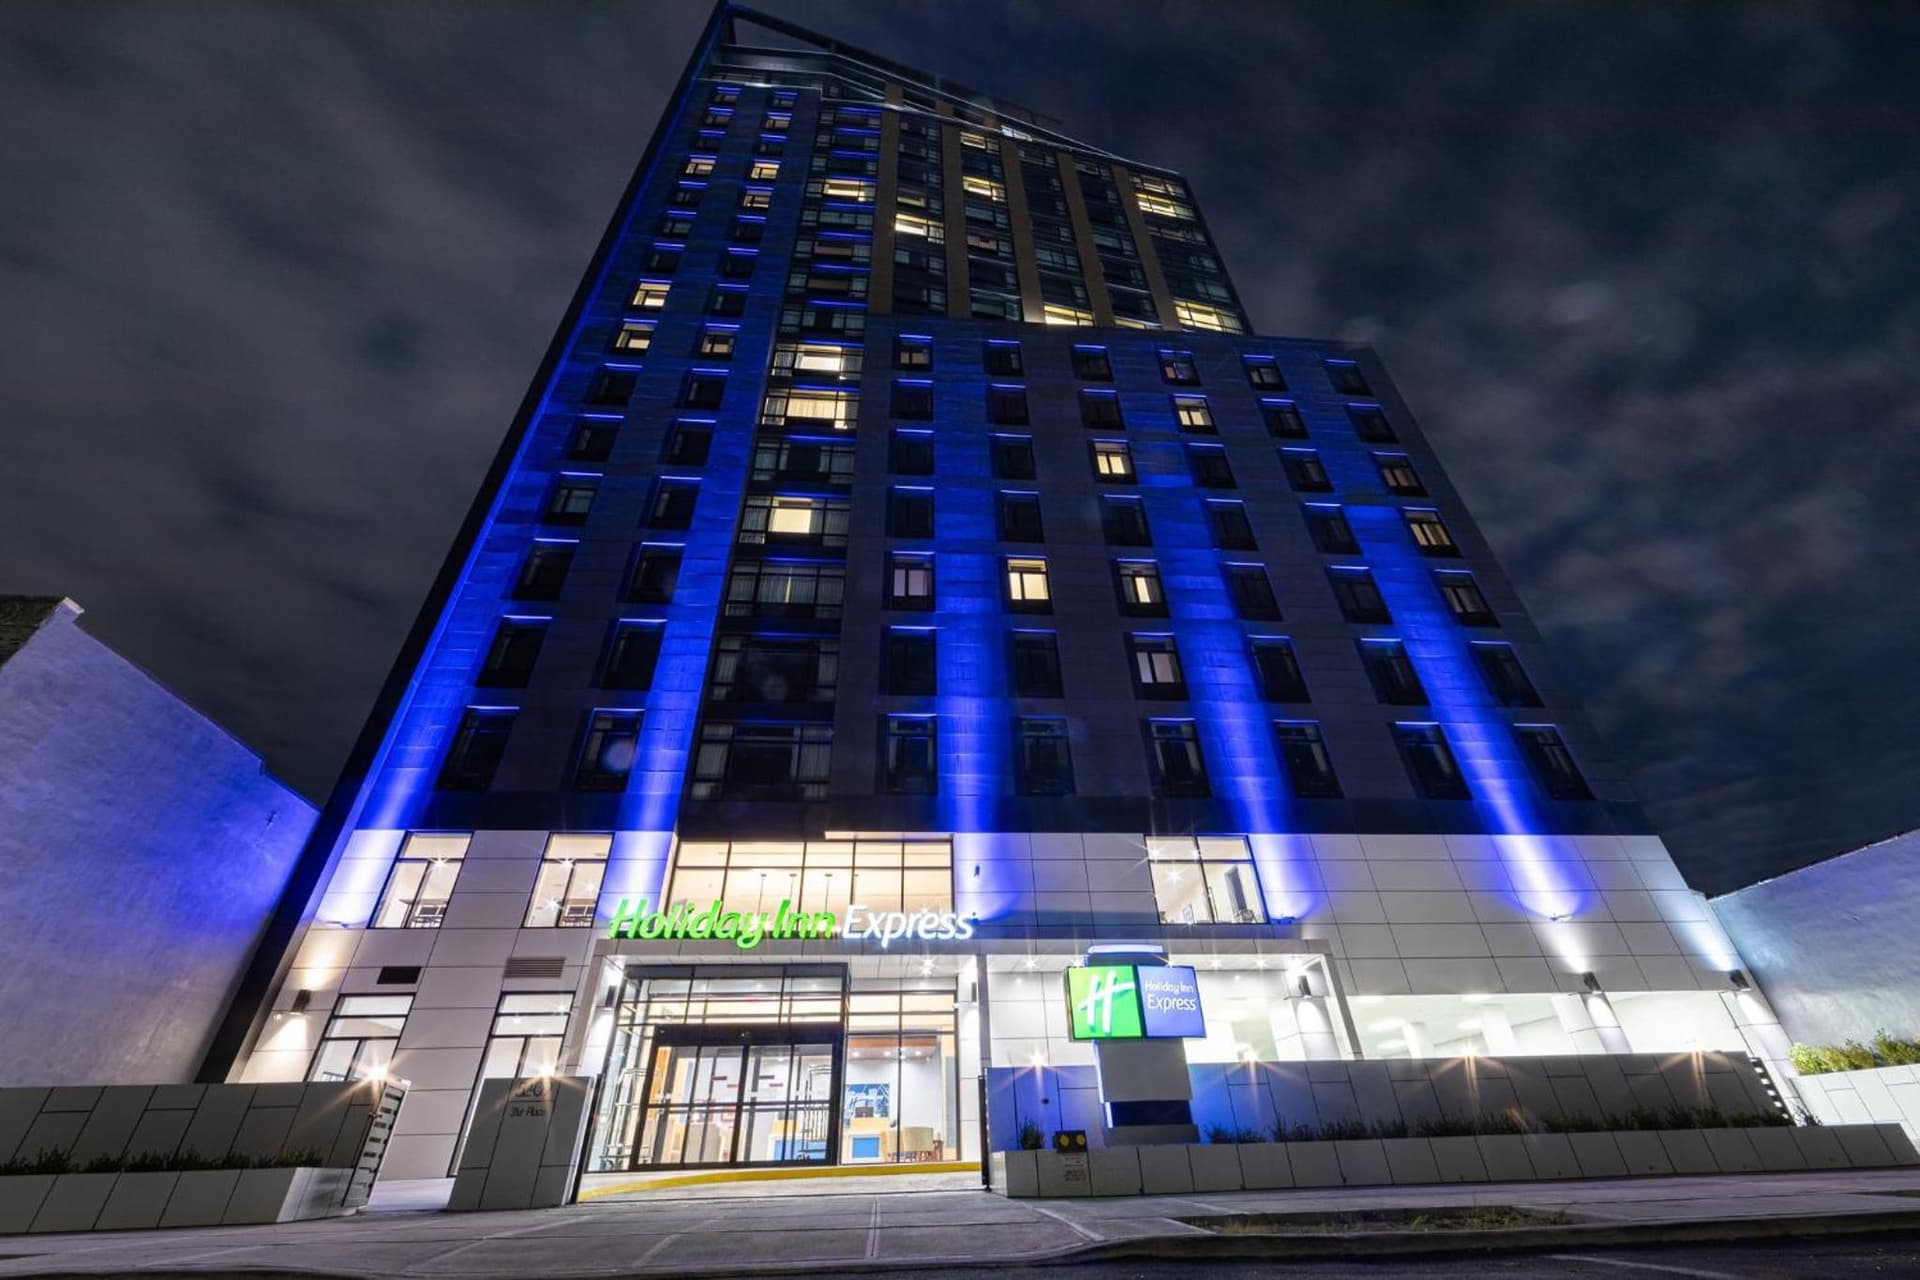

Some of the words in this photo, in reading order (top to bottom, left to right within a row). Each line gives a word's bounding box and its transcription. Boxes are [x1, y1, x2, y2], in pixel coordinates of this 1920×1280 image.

[608, 898, 769, 949] Holiday
[772, 899, 836, 940] Inn
[842, 904, 976, 949] Express
[1144, 980, 1179, 995] Holiday
[1179, 981, 1194, 993] Inn
[1148, 994, 1197, 1014] Express
